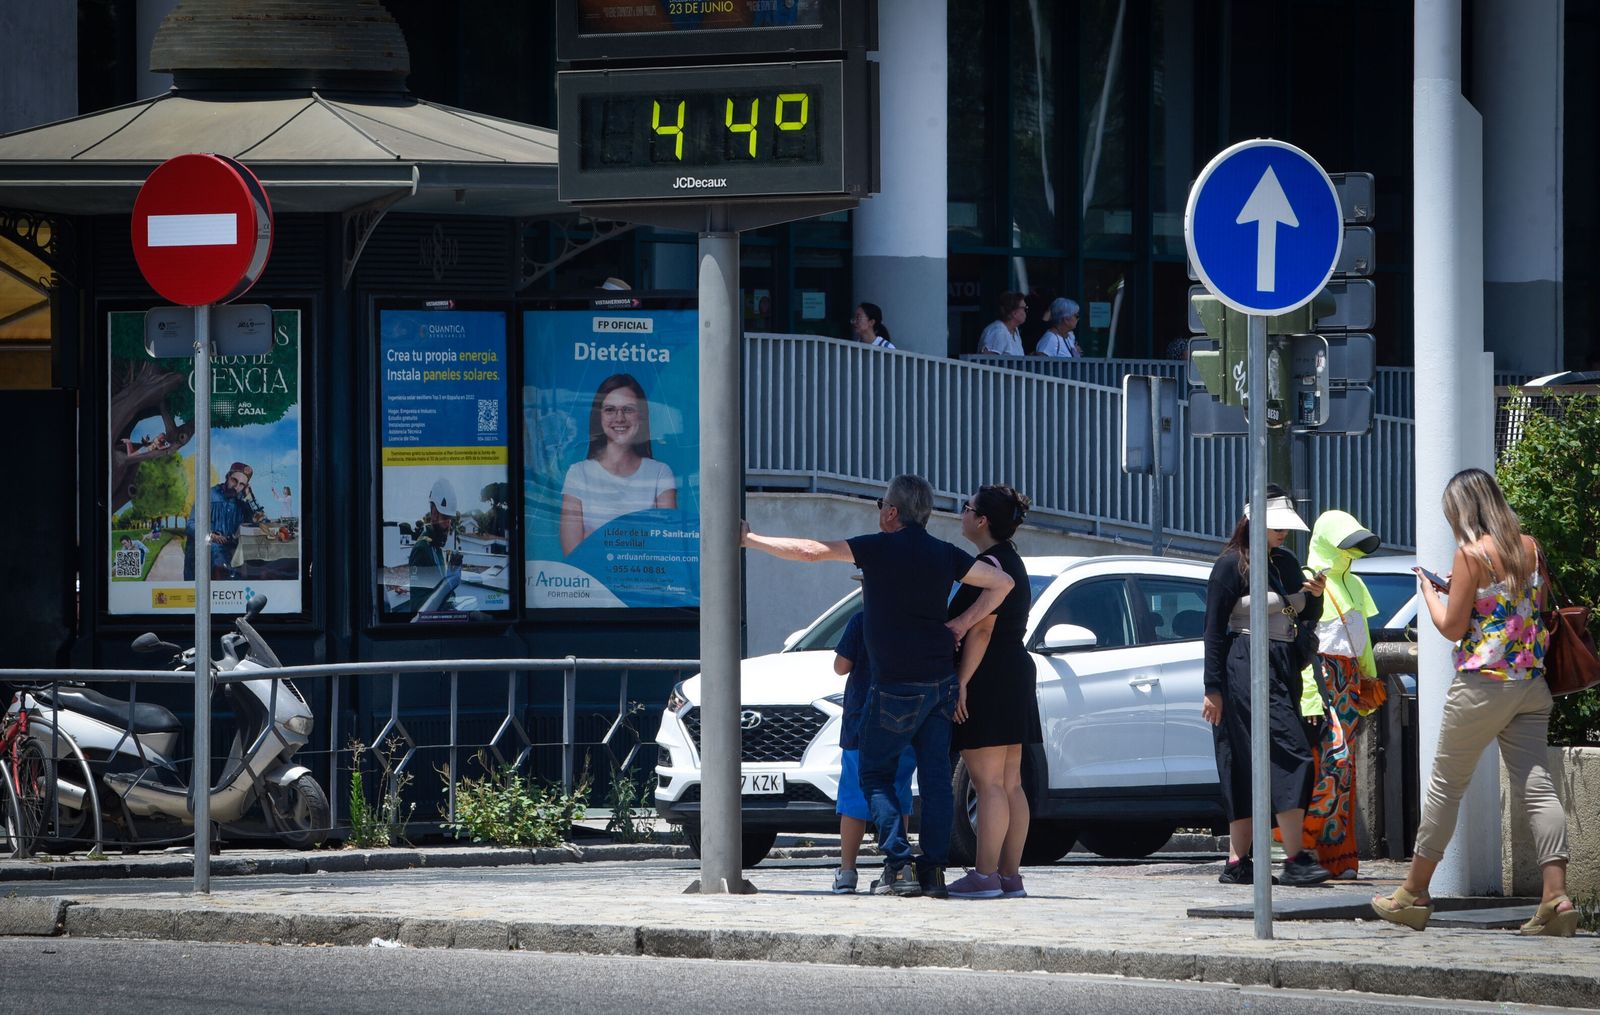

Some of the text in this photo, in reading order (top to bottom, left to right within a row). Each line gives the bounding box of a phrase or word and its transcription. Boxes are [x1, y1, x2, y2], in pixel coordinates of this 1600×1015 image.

[669, 3, 683, 15] 23
[685, 2, 698, 14] DE
[699, 1, 733, 14] JUNIO
[673, 177, 727, 189] JCDecaux
[598, 320, 648, 330] FP OFICIAL
[387, 349, 410, 361] Crea
[412, 350, 422, 361] tu
[425, 348, 457, 364] propia
[574, 342, 670, 363] Dietética
[387, 368, 500, 383] Instala paneles solares.
[629, 529, 639, 537] de
[650, 529, 661, 537] FP
[617, 553, 698, 562] arduanformacion.com
[212, 590, 243, 600] FECYT
[752, 775, 778, 791] KZK
